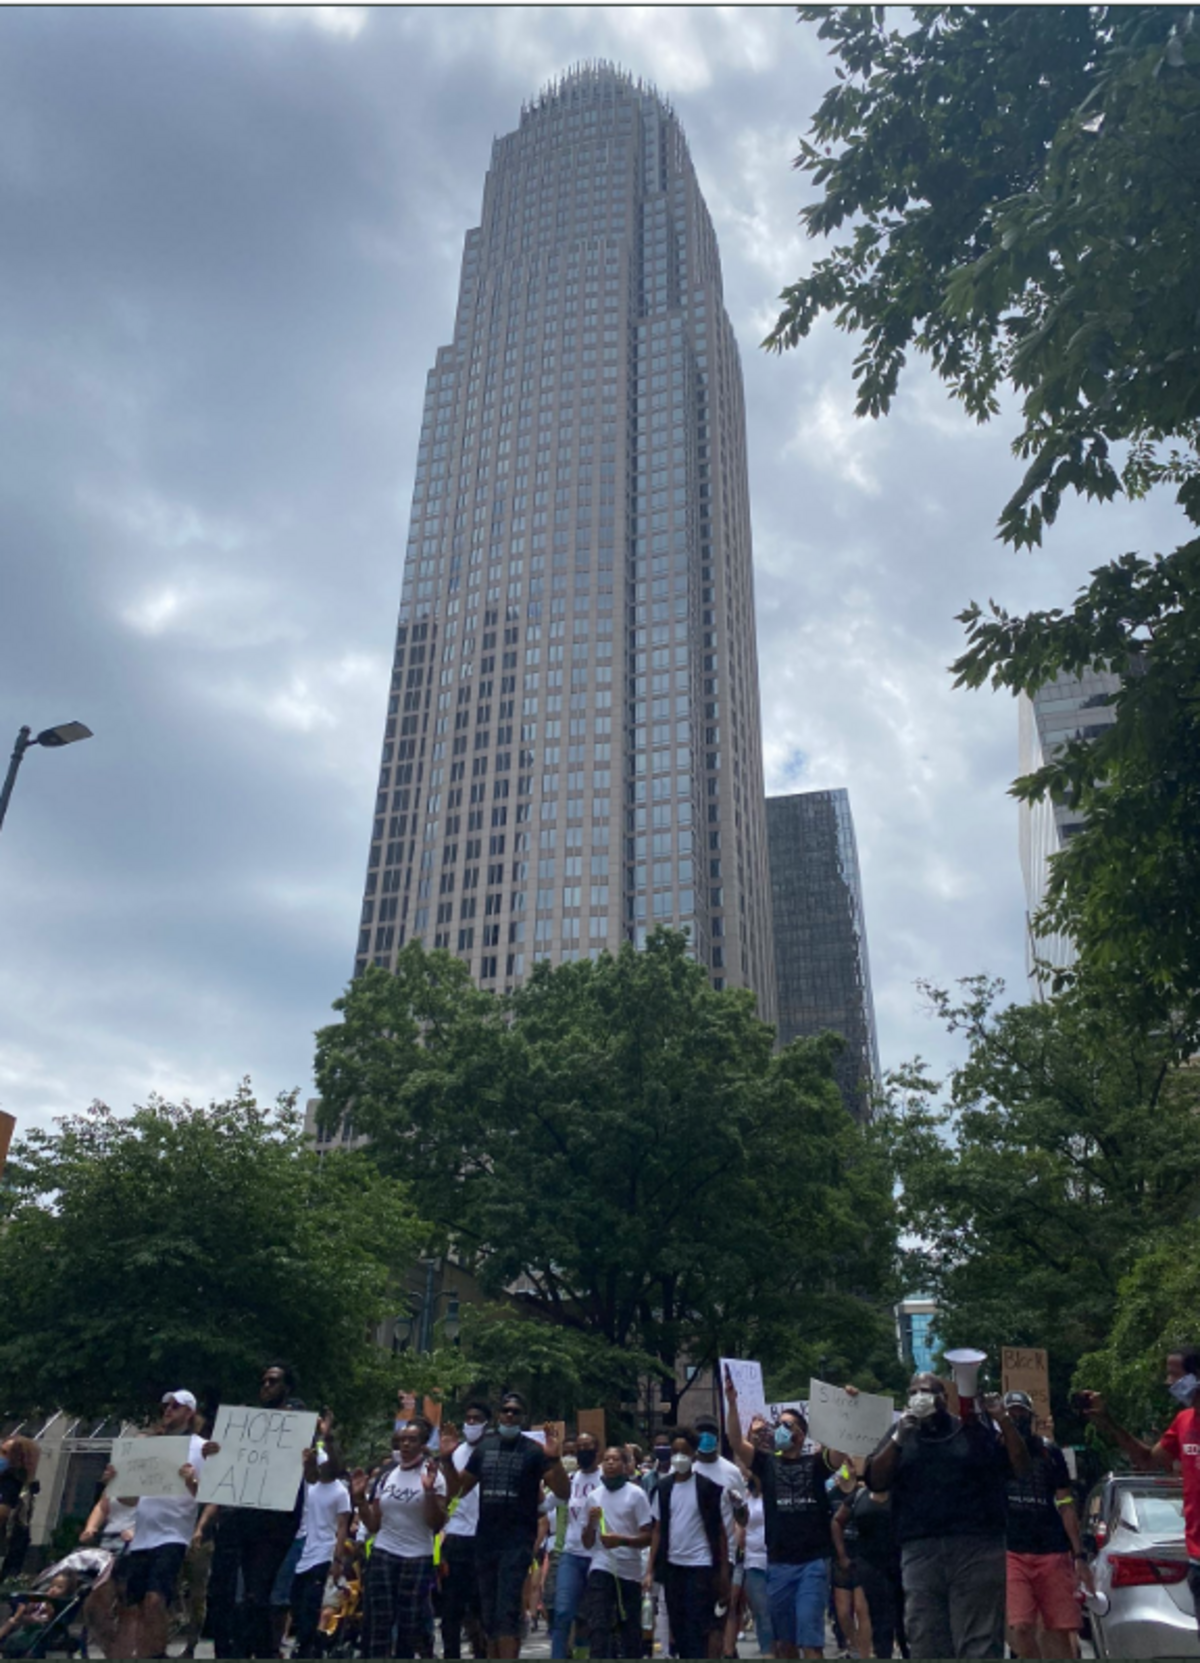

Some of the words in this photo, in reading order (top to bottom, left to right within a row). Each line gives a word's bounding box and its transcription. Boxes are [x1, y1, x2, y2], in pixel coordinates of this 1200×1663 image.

[1004, 1349, 1046, 1371] Black
[223, 1411, 298, 1449] HOPE
[237, 1447, 270, 1466] FOR
[210, 1465, 272, 1507] ALL
